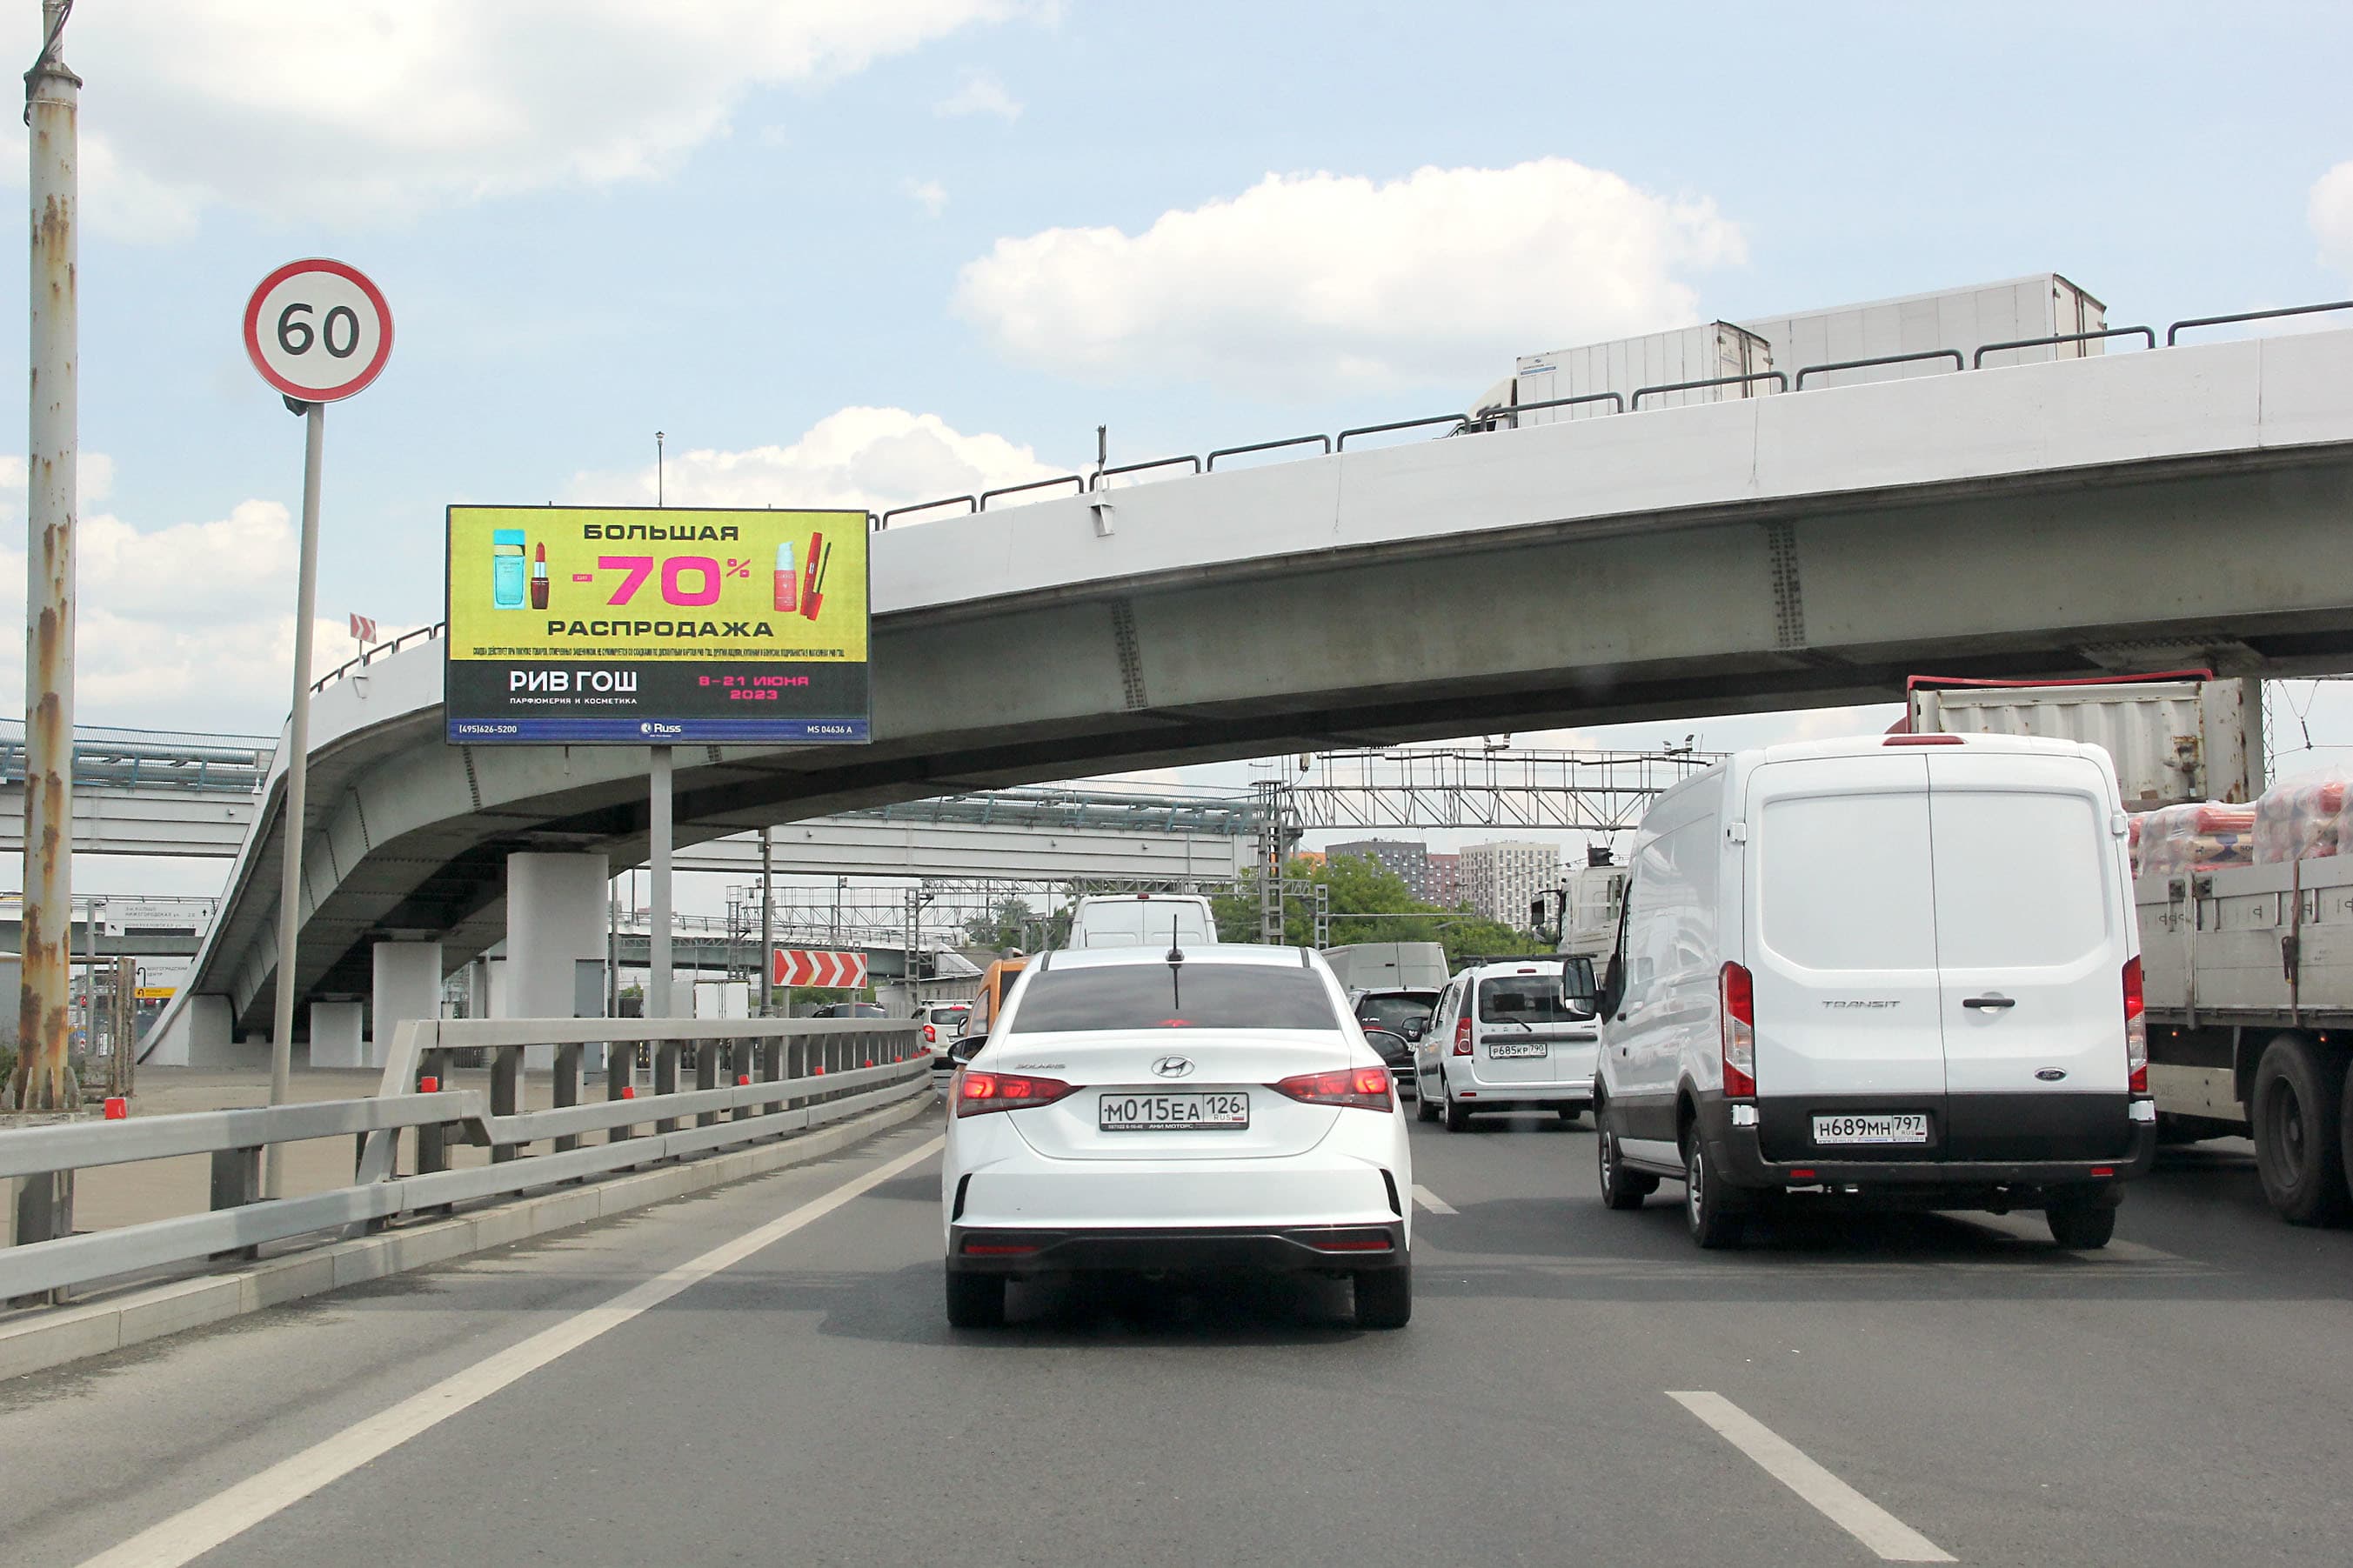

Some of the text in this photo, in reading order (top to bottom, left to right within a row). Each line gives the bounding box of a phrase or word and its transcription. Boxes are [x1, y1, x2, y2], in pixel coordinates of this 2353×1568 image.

[277, 303, 360, 358] 60
[584, 524, 739, 541] БОЛЬШАЯ
[548, 620, 774, 637] РАСПРОДАЖА
[510, 671, 637, 692] РИВ ГОШ
[753, 676, 810, 687] ИЮНЯ
[730, 690, 779, 700] 2023
[459, 724, 518, 734] (495)626-5200
[653, 723, 682, 733] Russ
[1822, 1000, 1901, 1009] TRANSIT
[1107, 1096, 1240, 1122] М015ЕА 126
[1819, 1116, 1922, 1137] Н689МН 797
